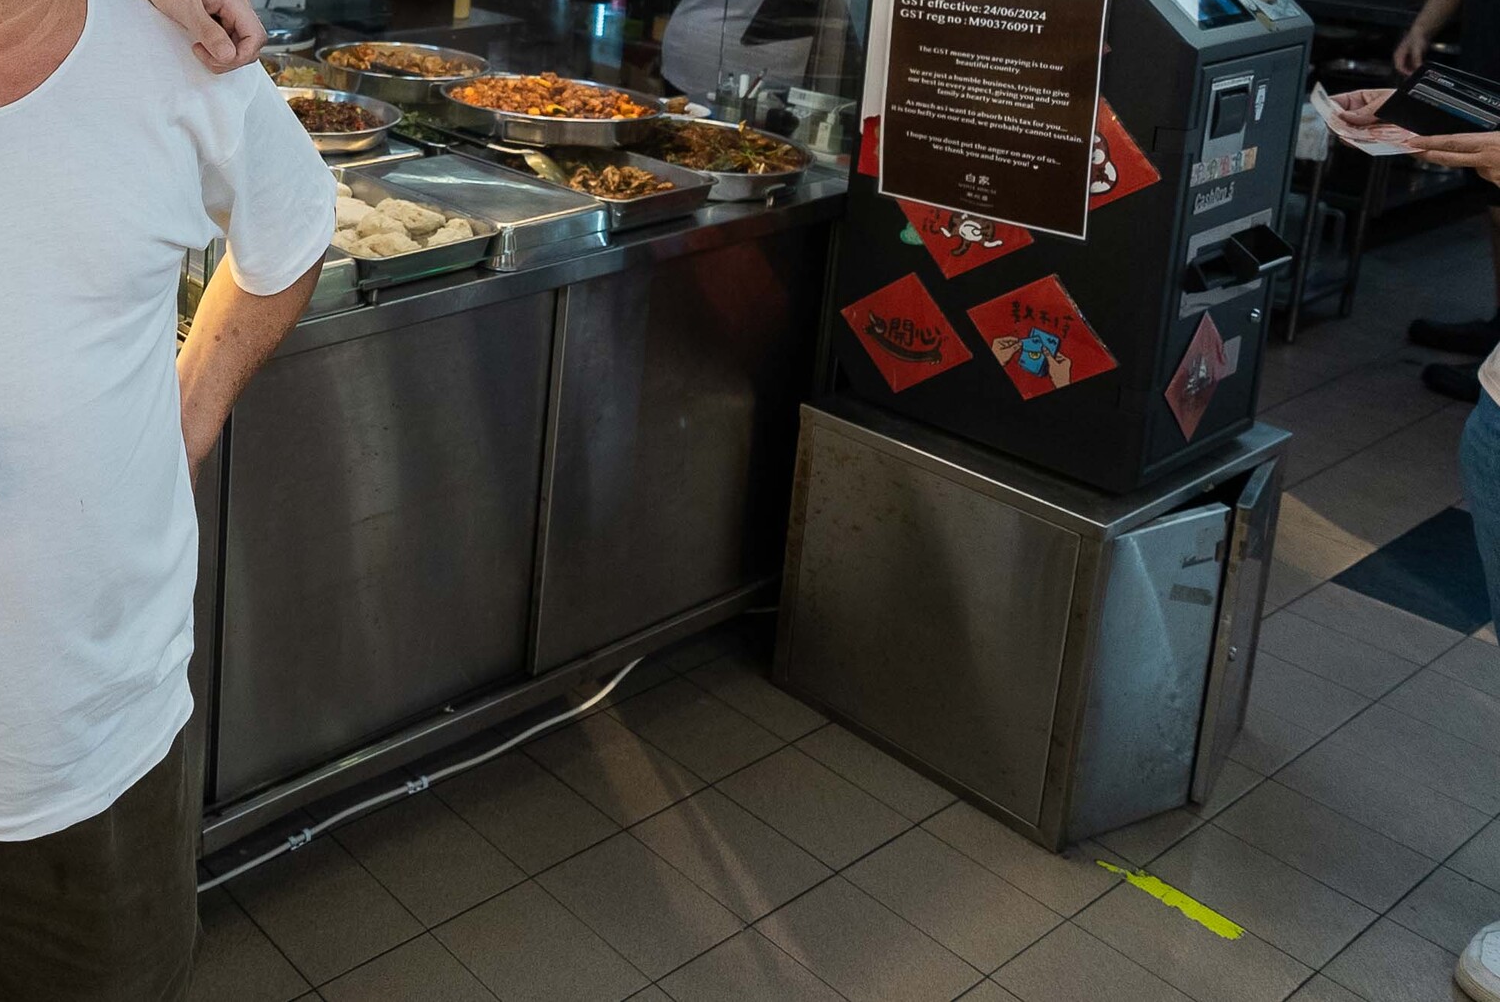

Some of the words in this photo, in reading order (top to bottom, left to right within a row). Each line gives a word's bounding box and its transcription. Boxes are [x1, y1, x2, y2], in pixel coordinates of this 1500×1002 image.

[900, 9, 924, 19] GST
[927, 13, 945, 24] reg
[948, 16, 961, 24] no
[928, 0, 981, 13] effective:
[984, 5, 1047, 21] 24/06/2024
[919, 45, 931, 53] The
[950, 50, 975, 58] money
[1005, 58, 1031, 68] paying
[956, 59, 988, 69] beautiful
[922, 78, 936, 86] best
[946, 83, 966, 91] every
[995, 90, 1018, 99] giving
[934, 71, 947, 79] just
[954, 74, 981, 84] humble
[1018, 84, 1041, 95] trying
[1053, 90, 1069, 98] give
[937, 88, 959, 98] family
[966, 93, 990, 103] hearty
[992, 98, 1012, 106] warm
[918, 109, 936, 118] hefty
[990, 121, 1023, 134] probably
[1025, 128, 1052, 138] cannot
[949, 107, 966, 115] want
[977, 111, 1002, 120] absorb
[1004, 115, 1018, 124] this
[910, 131, 927, 140] hope
[988, 147, 1009, 155] anger
[1022, 153, 1035, 161] any
[945, 146, 964, 155] thank
[995, 155, 1011, 164] love
[1013, 159, 1029, 167] you!
